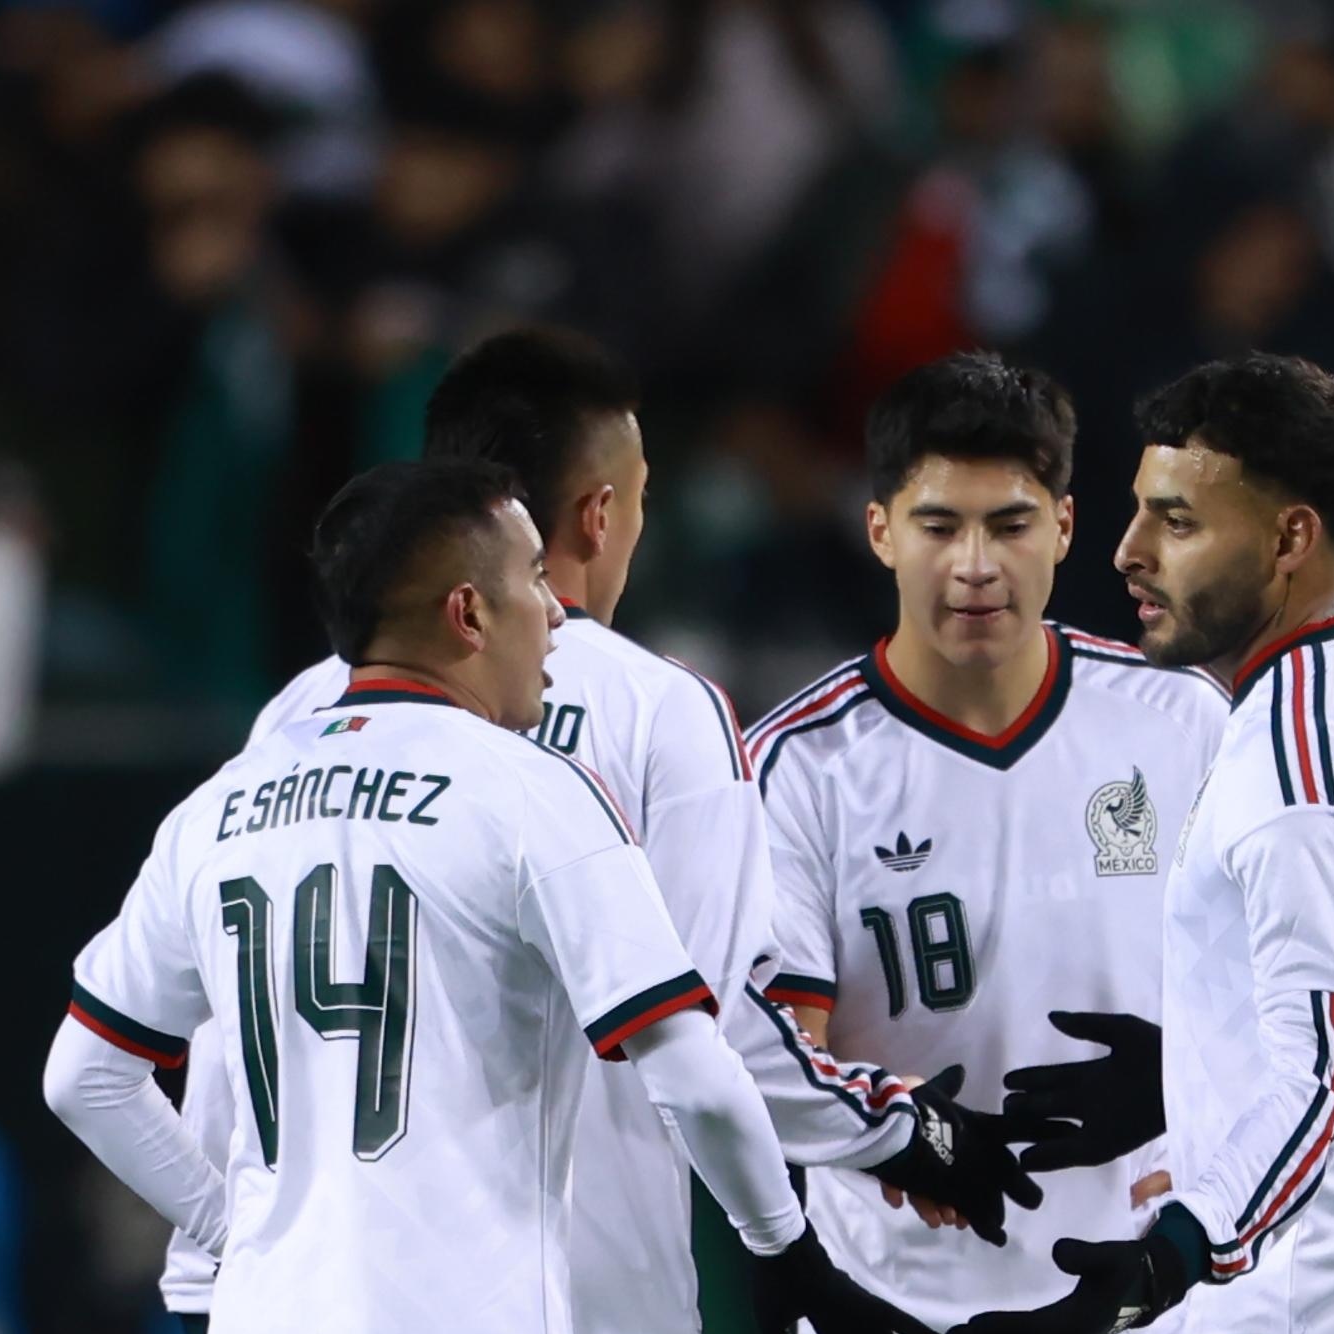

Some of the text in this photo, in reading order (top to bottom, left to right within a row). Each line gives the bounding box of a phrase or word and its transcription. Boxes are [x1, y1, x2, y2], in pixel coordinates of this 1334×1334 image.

[216, 763, 451, 842] E.SÁNCHEZ
[219, 862, 419, 1173] 14
[859, 891, 979, 1021] 18
